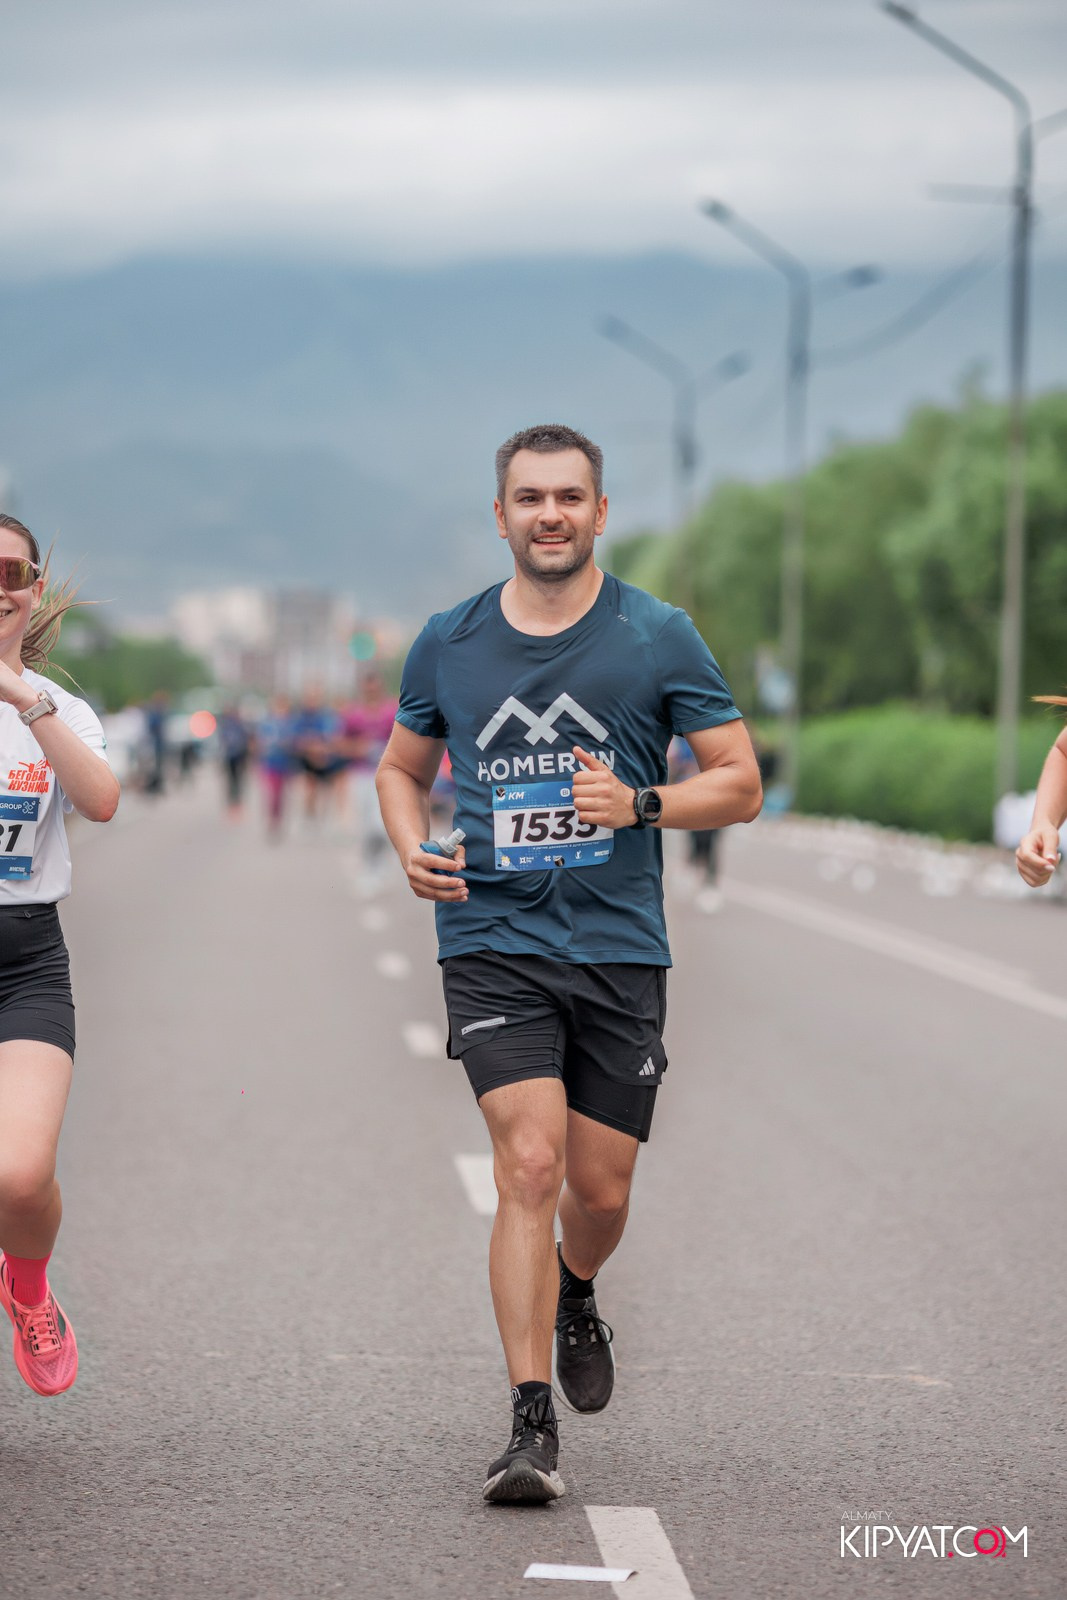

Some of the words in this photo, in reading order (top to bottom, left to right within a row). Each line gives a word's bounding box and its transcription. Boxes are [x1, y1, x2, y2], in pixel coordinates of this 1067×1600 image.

[0, 802, 23, 810] GROUP
[0, 823, 23, 852] 1
[511, 810, 598, 844] 1535
